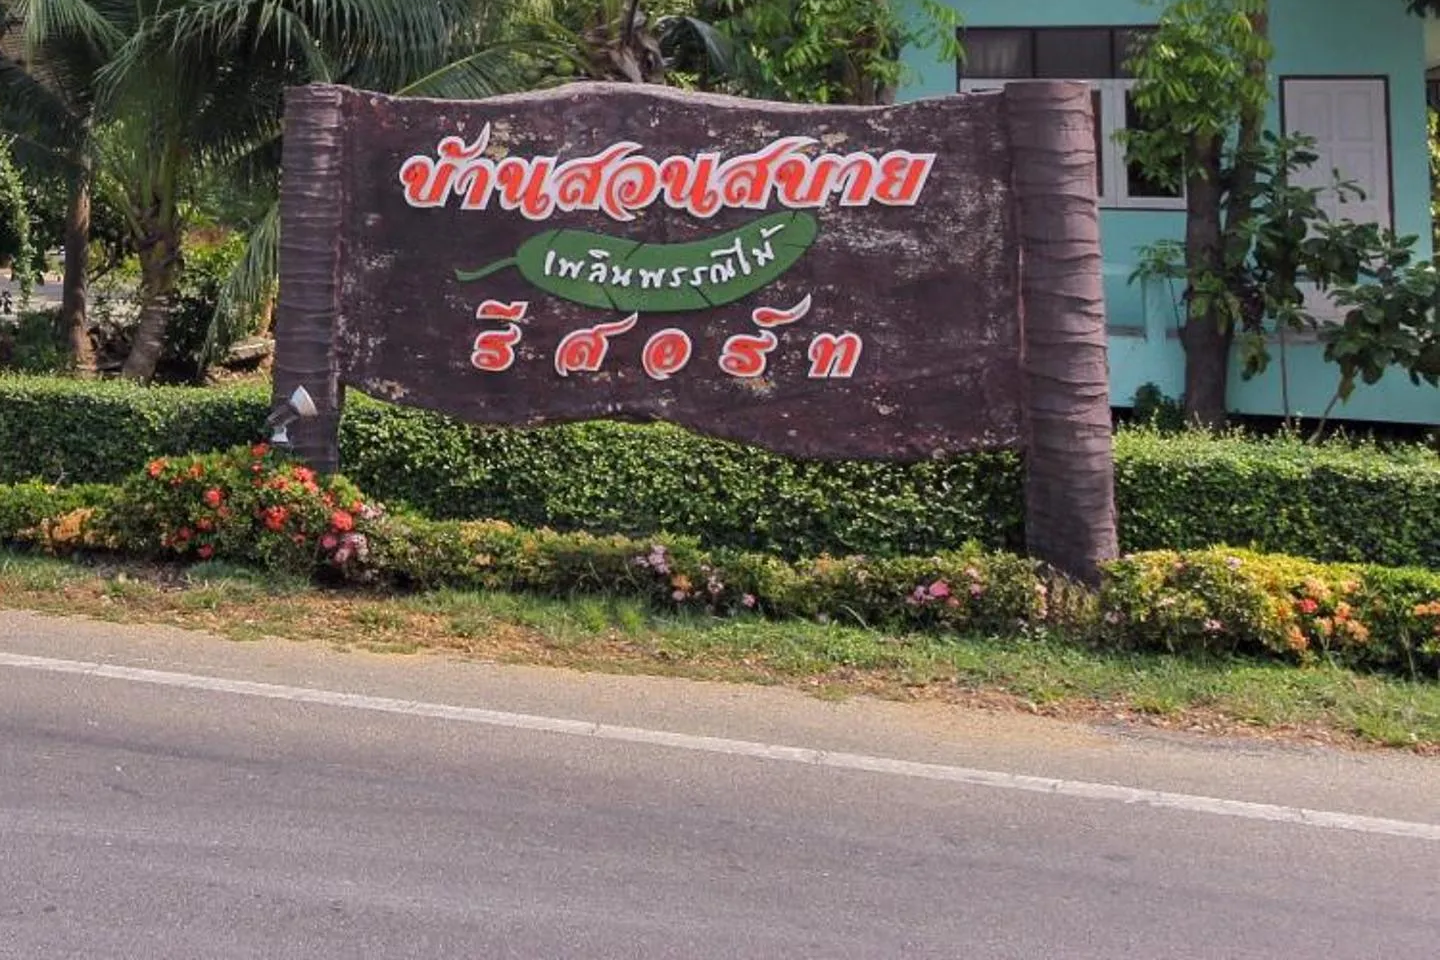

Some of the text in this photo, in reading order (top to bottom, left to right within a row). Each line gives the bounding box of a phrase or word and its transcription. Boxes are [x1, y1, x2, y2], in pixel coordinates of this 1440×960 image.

[400, 121, 937, 221] บ้านสวนสบาย
